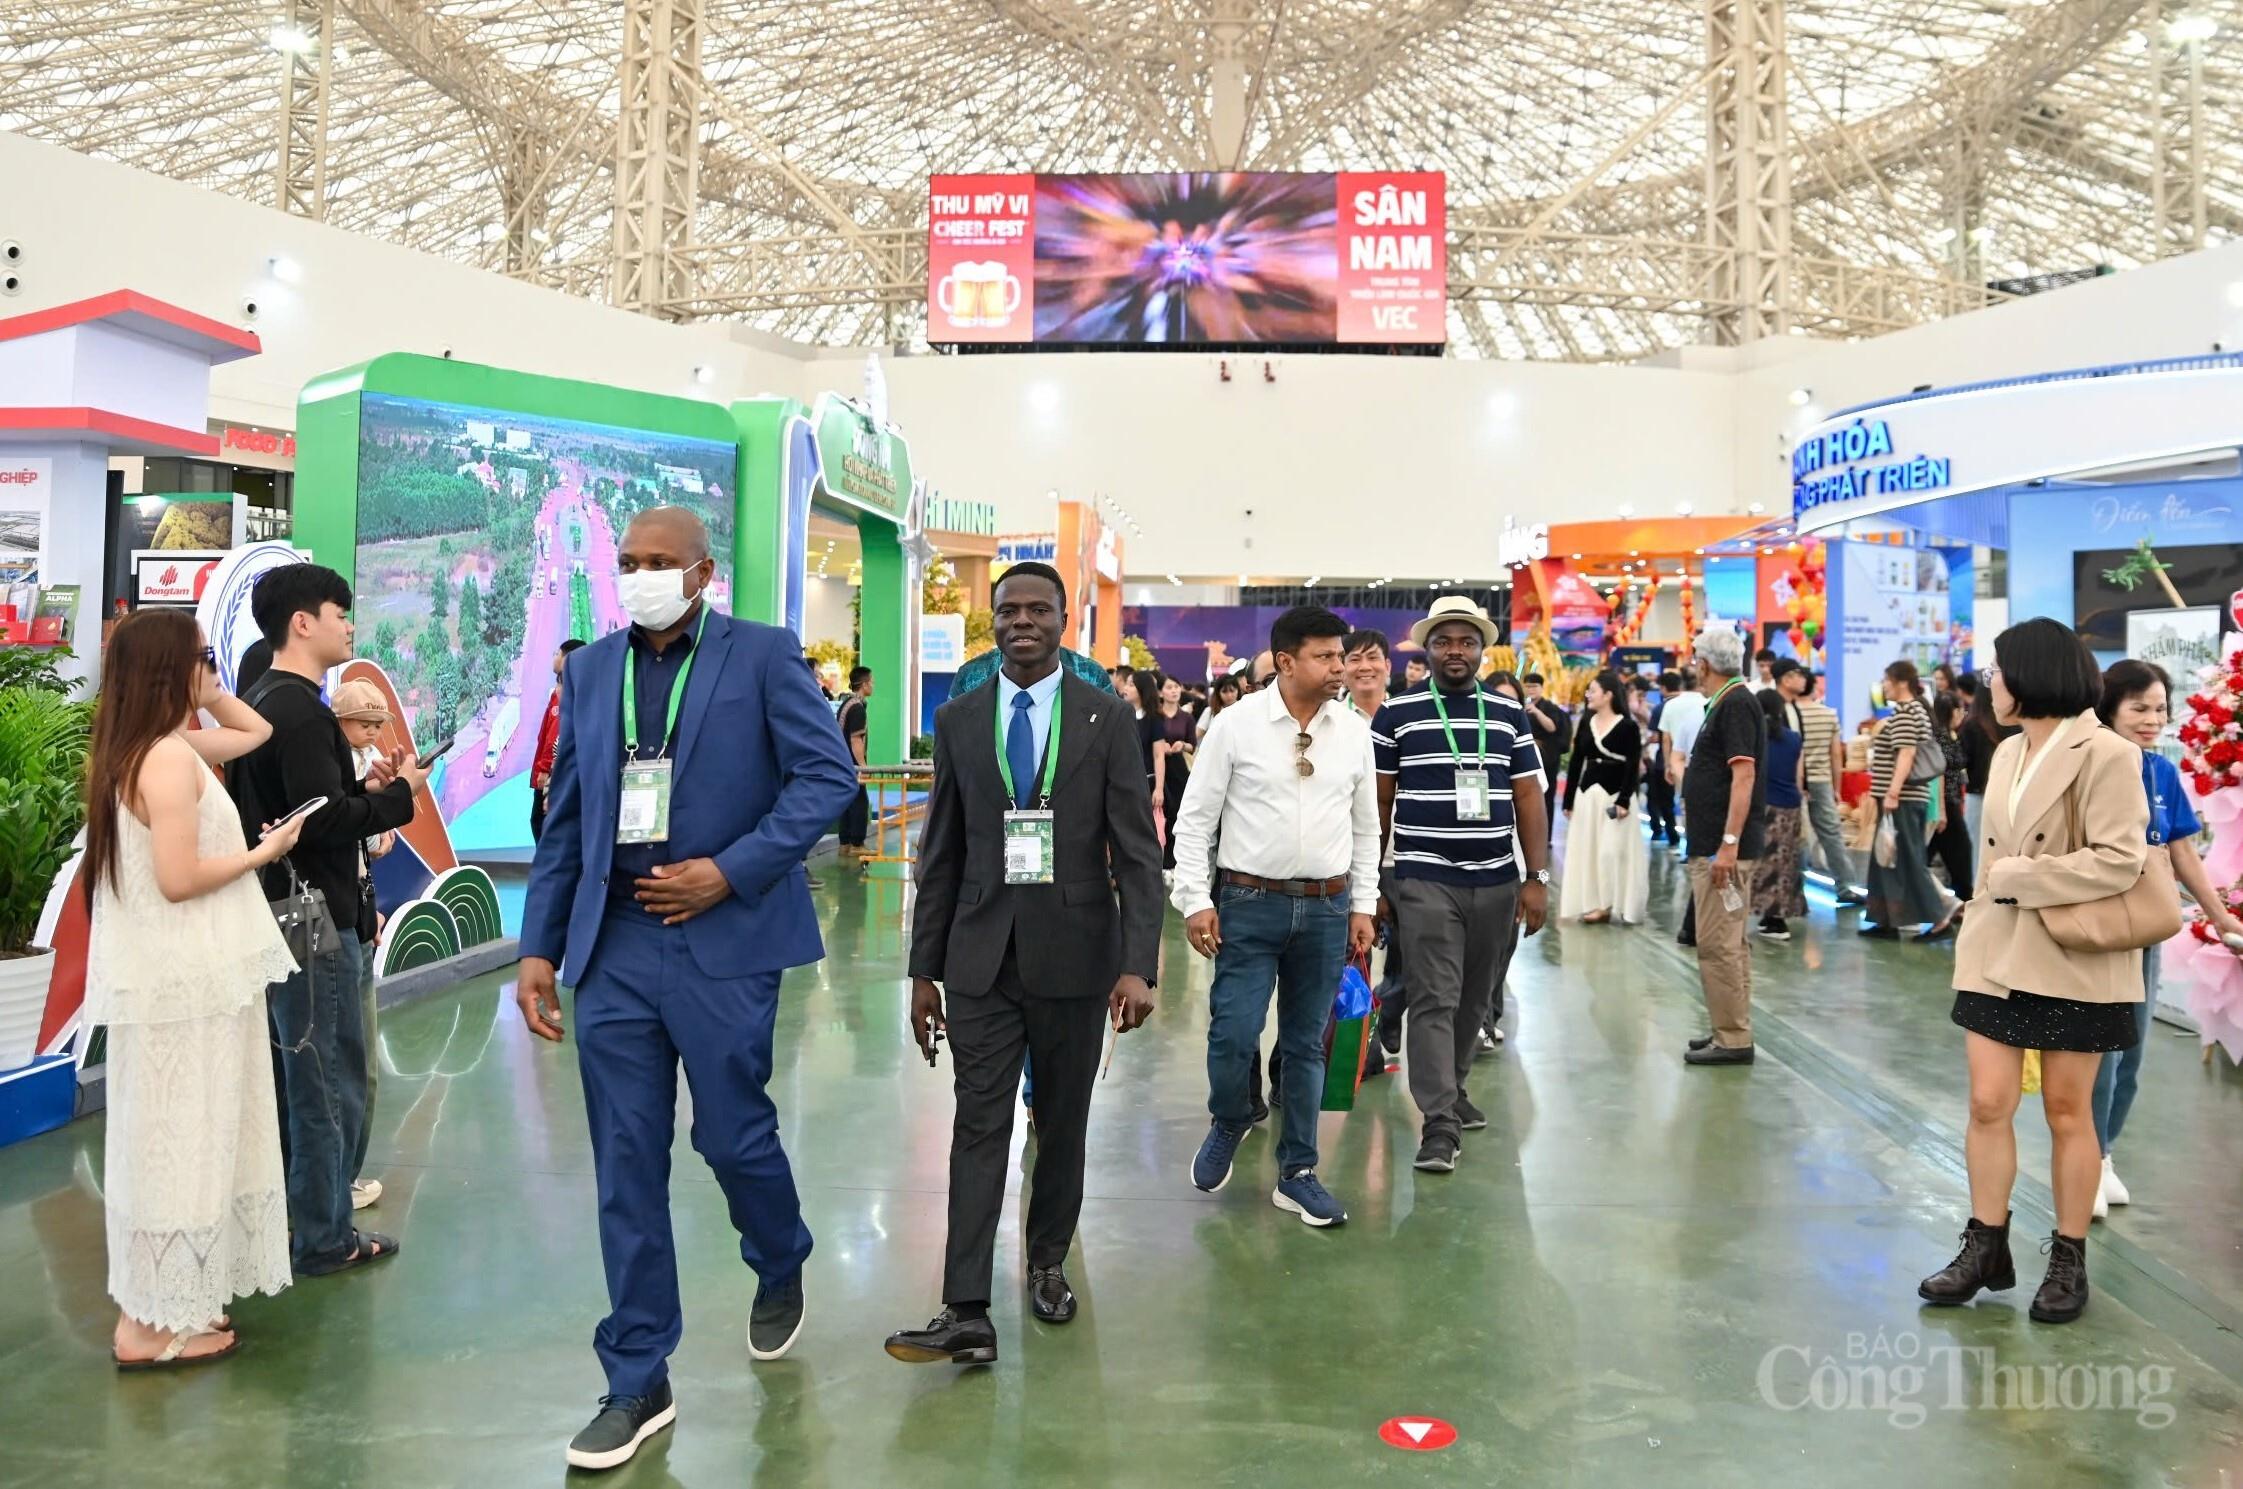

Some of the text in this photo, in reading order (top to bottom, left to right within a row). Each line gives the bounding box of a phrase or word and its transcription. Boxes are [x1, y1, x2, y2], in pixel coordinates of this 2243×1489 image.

[931, 194, 970, 215] THU
[1354, 183, 1427, 226] SÂN
[933, 220, 1026, 237] CHEER FEST
[1350, 235, 1432, 270] NAM
[1372, 305, 1418, 331] VEC
[1826, 418, 1893, 465] HÓA
[1819, 466, 1870, 503] PHÁT
[944, 499, 997, 536] MINH
[144, 586, 190, 597] Dongtam
